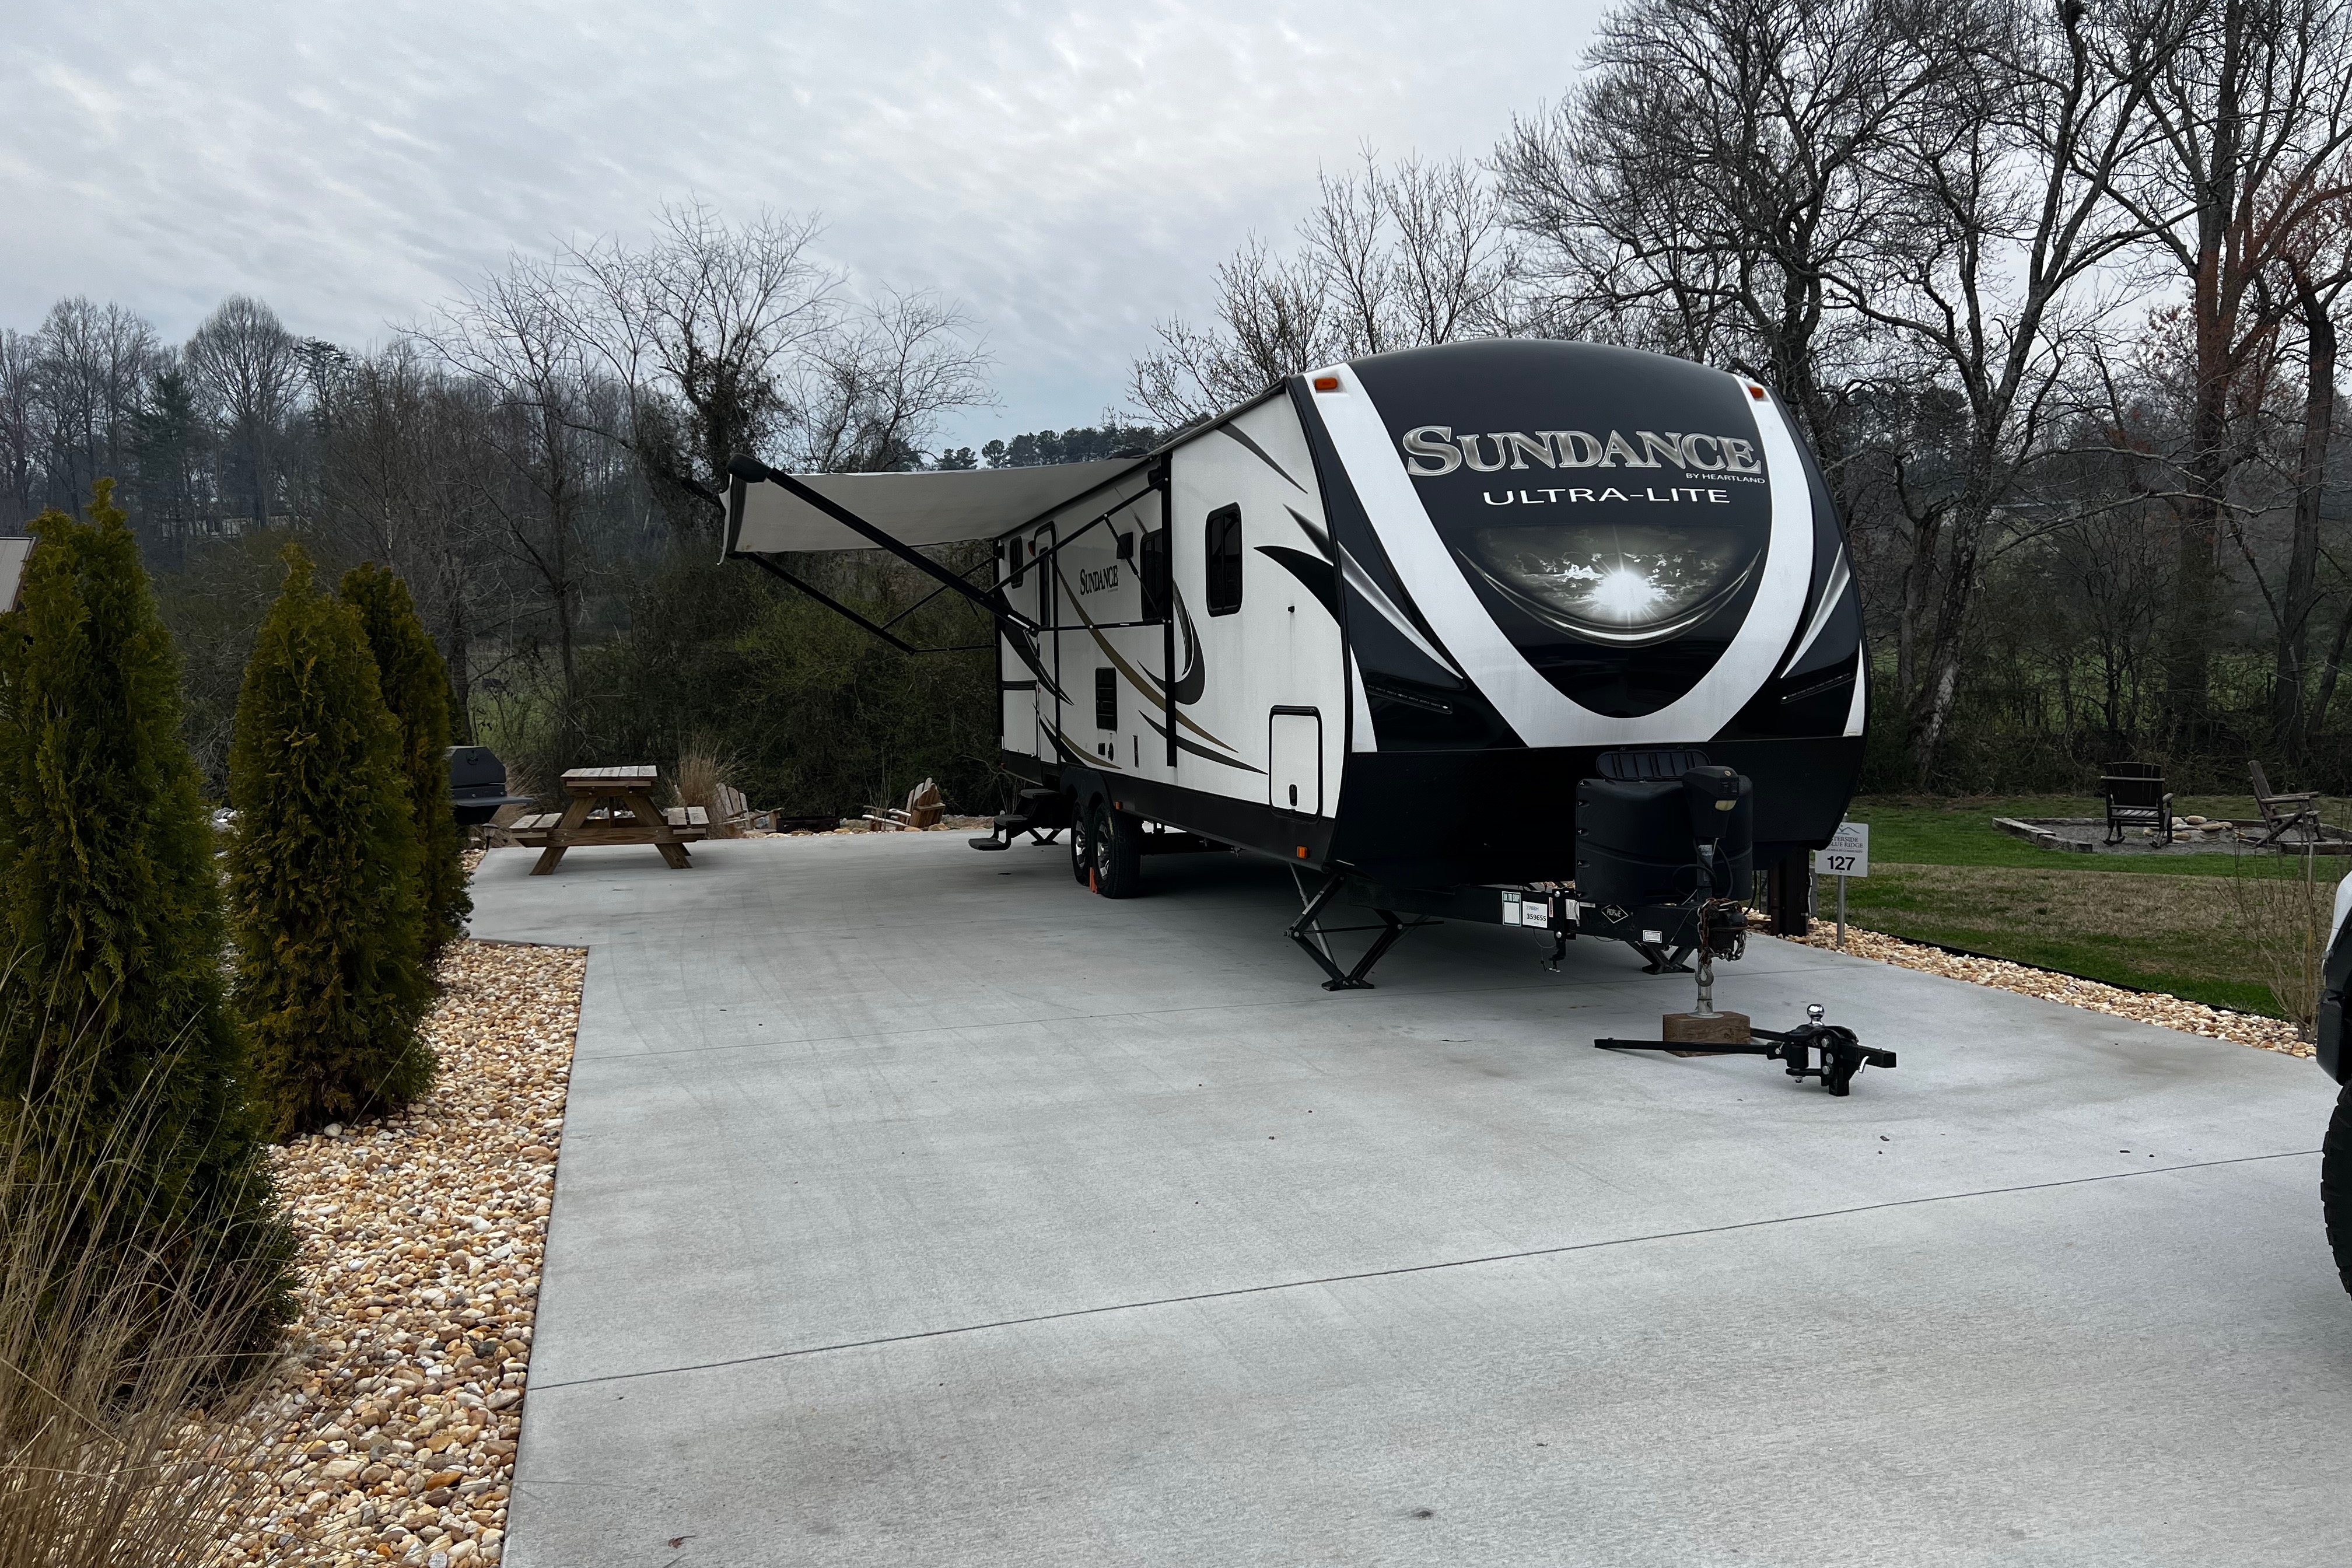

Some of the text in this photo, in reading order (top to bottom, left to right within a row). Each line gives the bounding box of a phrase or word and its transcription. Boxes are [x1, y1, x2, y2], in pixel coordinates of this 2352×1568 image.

[1403, 425, 1761, 476] SUNDANCE
[1702, 474, 1766, 484] HEARTLAND
[1483, 487, 1730, 506] ULTRA-LITE
[1080, 565, 1119, 596] SUNDANCE
[1827, 856, 1856, 871] 127
[1527, 913, 1546, 922] 359655
